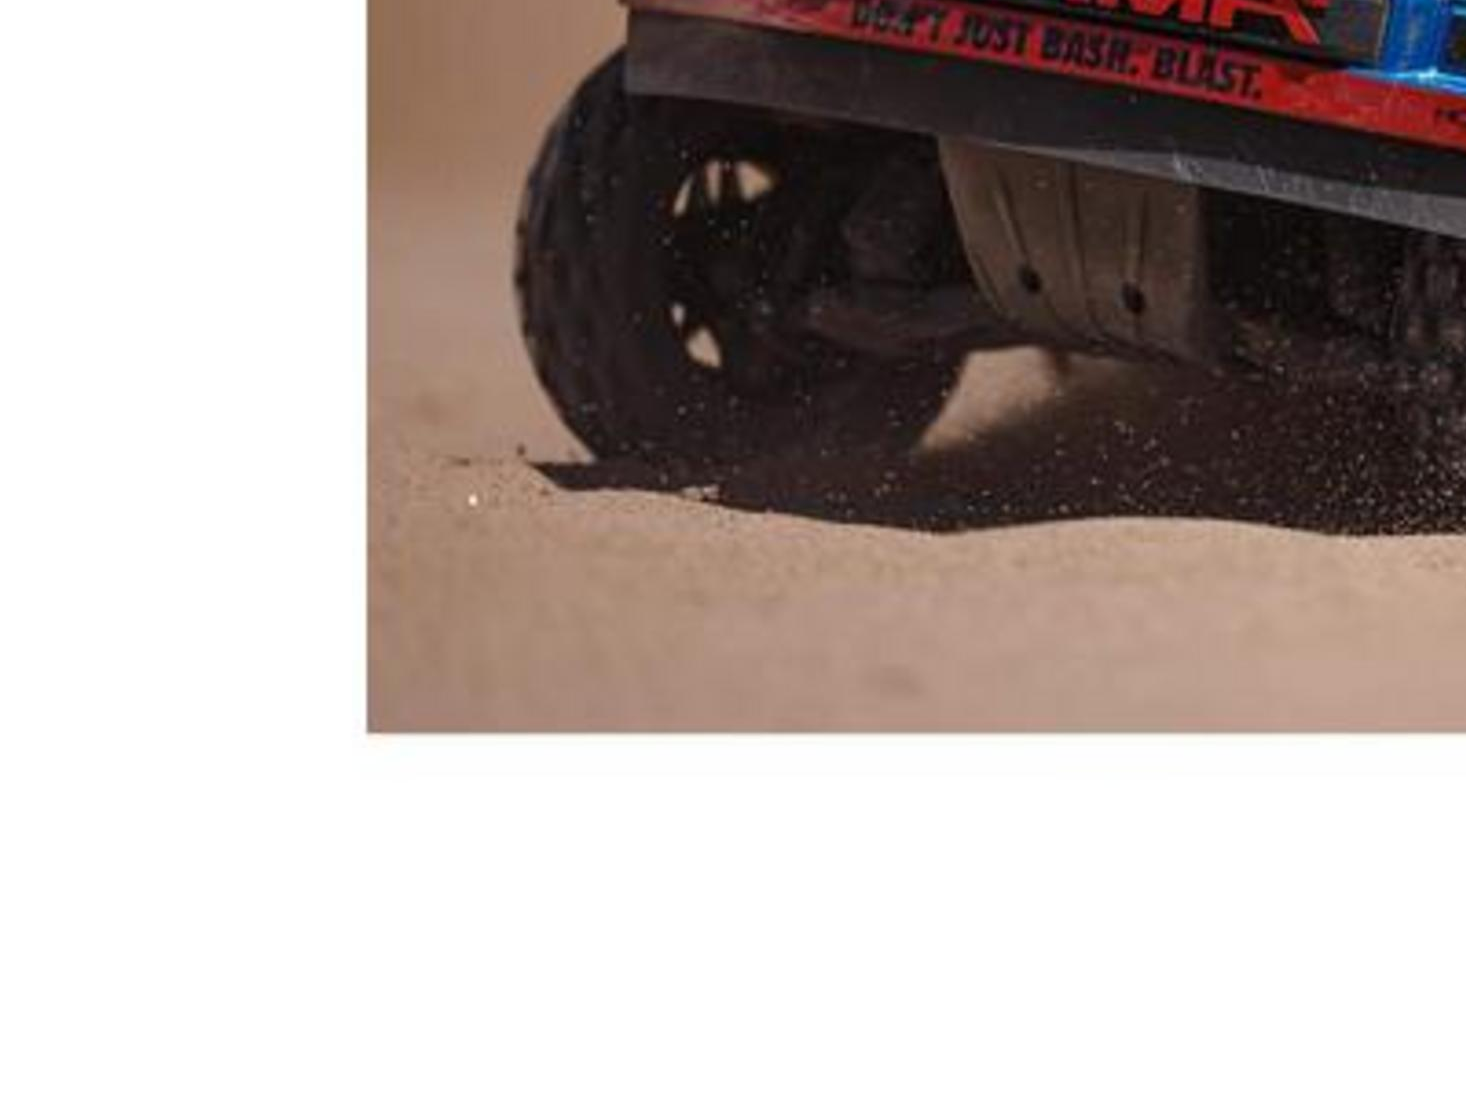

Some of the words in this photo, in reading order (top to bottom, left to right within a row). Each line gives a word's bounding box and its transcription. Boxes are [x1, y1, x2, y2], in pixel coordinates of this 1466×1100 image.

[953, 10, 1031, 57] JUST
[1041, 22, 1139, 77] BASH.
[1153, 44, 1263, 100] BLAST.
